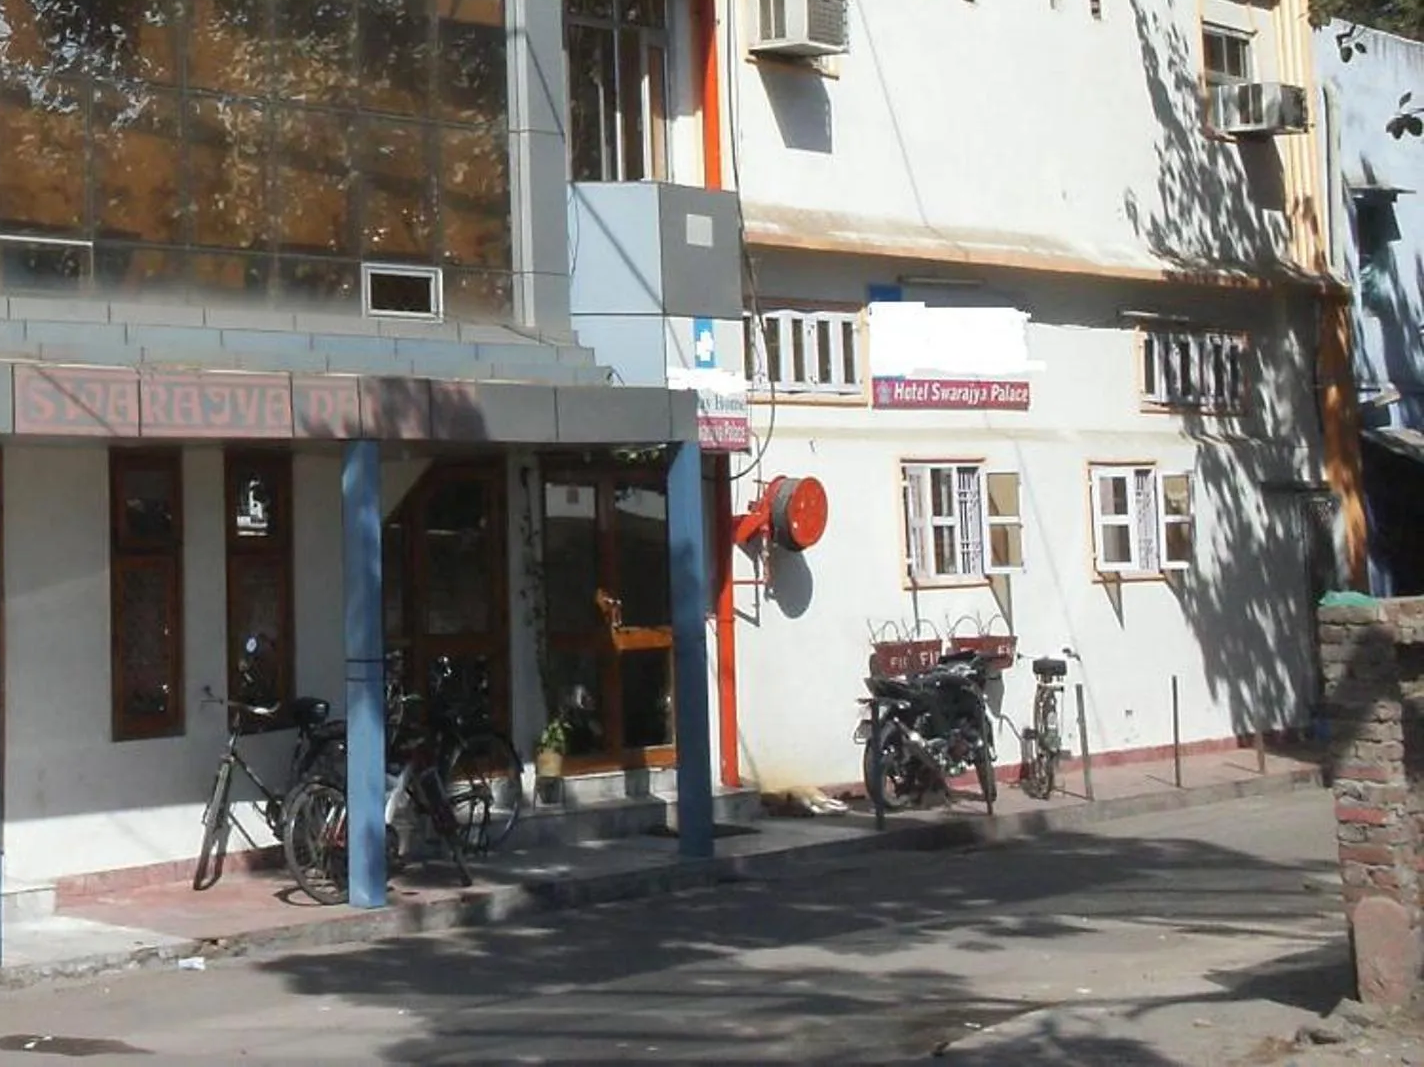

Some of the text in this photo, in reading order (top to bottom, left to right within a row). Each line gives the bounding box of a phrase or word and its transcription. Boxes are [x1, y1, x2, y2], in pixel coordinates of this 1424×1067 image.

[895, 382, 1029, 405] Hotel Swarajya Palace
